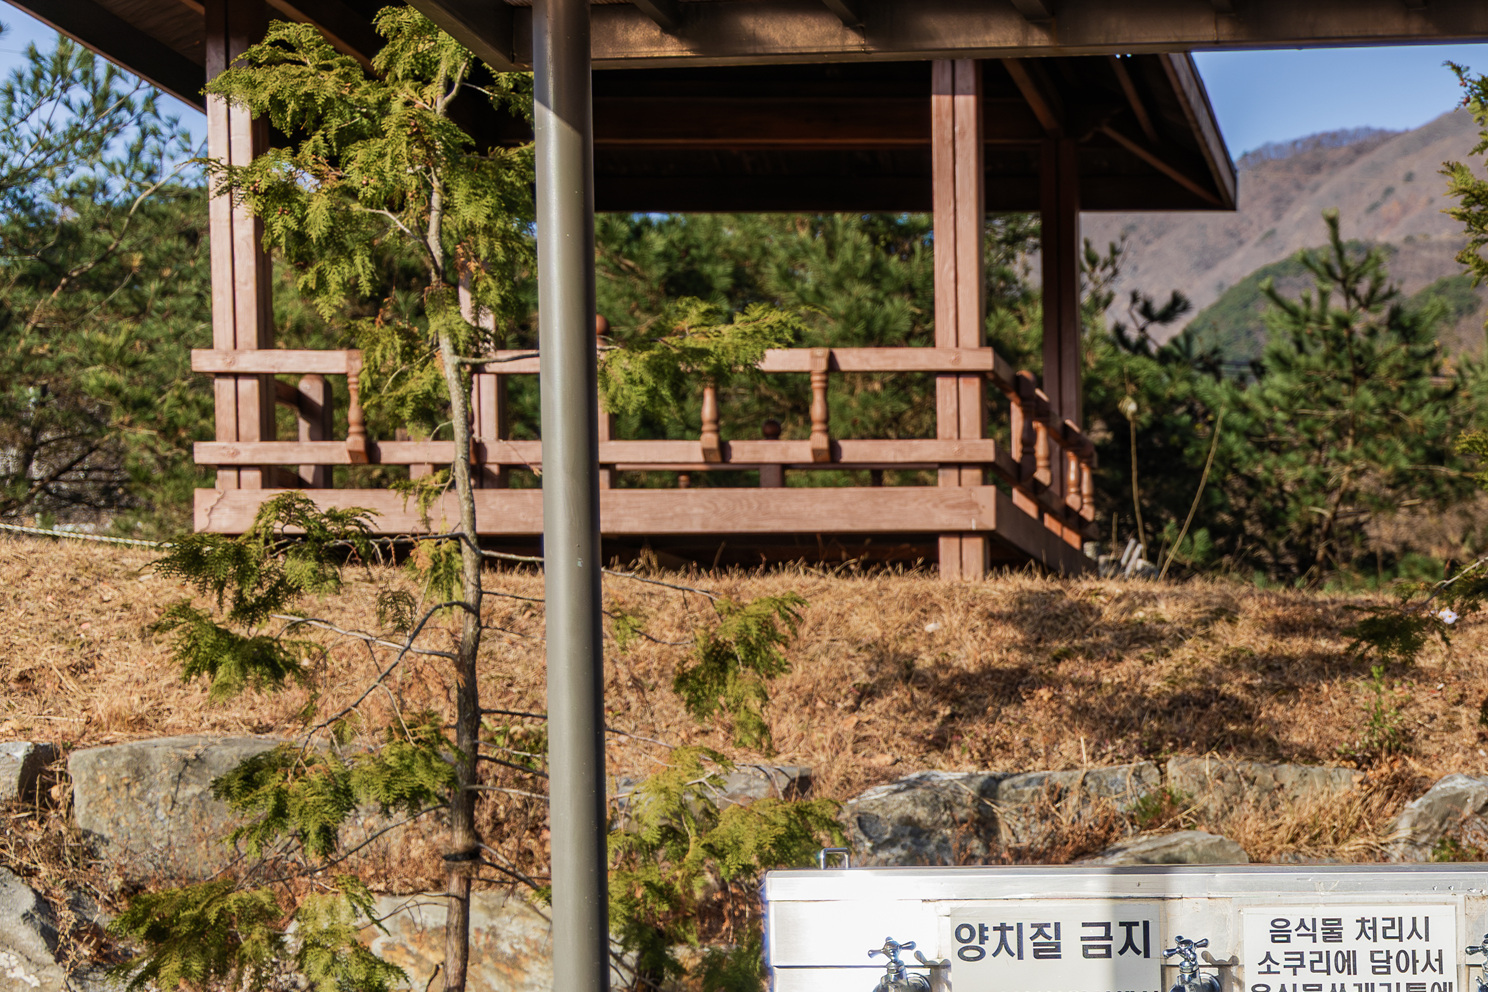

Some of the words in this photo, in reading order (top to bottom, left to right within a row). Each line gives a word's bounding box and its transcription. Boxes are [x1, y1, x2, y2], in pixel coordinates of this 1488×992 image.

[954, 921, 1062, 962] 양치질
[1080, 920, 1150, 959] 금지
[1269, 917, 1343, 943] 음식물
[1355, 916, 1430, 942] 처리시
[1258, 950, 1357, 975] 소쿠리에
[1370, 949, 1443, 975] 담아서
